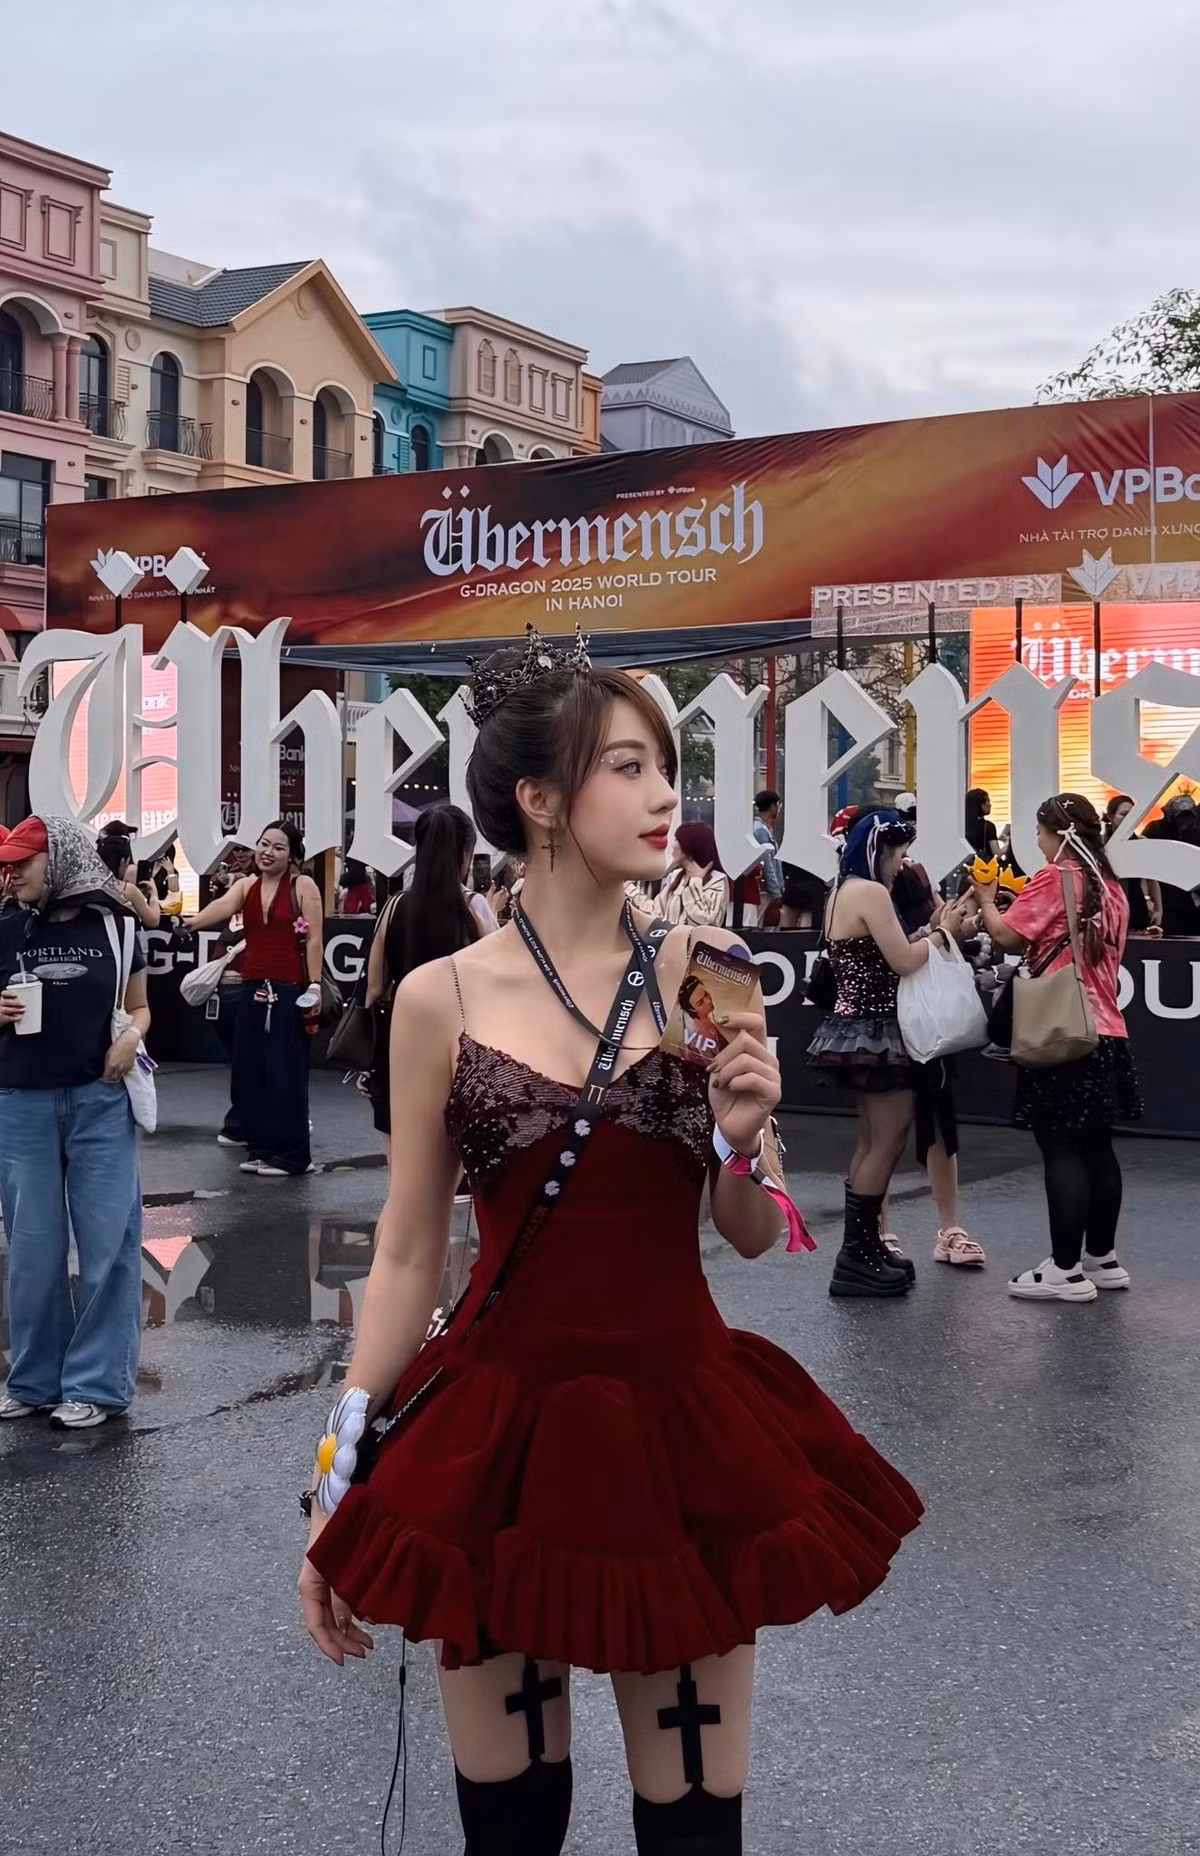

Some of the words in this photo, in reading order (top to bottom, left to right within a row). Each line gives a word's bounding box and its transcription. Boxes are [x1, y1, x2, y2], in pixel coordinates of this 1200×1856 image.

[419, 481, 764, 577] Übermensch
[1019, 530, 1050, 543] NHÀ
[1053, 528, 1074, 541] TÀI
[1078, 527, 1109, 540] TRỢ
[460, 579, 547, 598] G-DRAGON
[552, 577, 593, 593] 2025
[598, 573, 662, 590] WORLD
[666, 568, 717, 585] TOUR
[813, 577, 1001, 608] PRESENTED
[1013, 575, 1057, 600] BY
[545, 598, 563, 611] IN
[568, 595, 623, 610] HANOI
[22, 946, 103, 958] ORTLAND
[696, 949, 752, 987] Übermensch
[596, 999, 635, 1072] Übemensch
[684, 1028, 718, 1052] VIP
